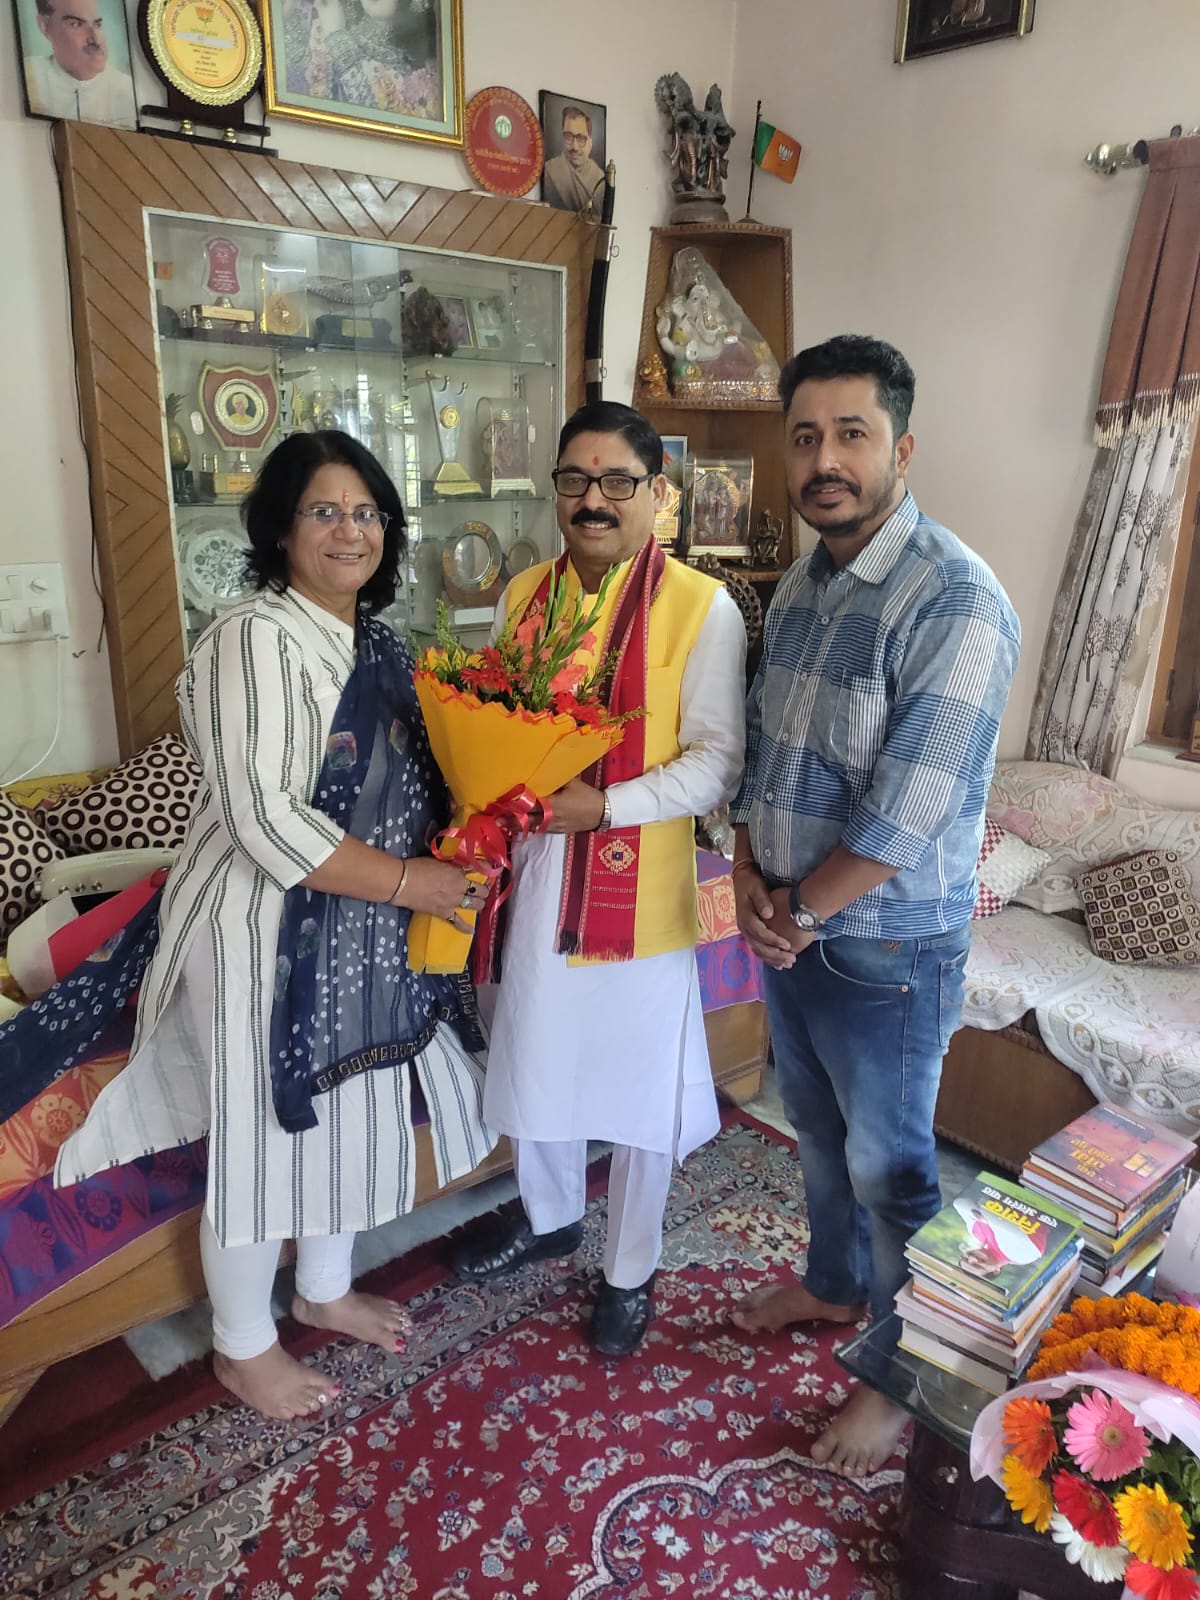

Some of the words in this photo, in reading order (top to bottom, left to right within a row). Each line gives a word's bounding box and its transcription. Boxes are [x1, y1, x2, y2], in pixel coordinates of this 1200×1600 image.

[981, 1186, 1002, 1200] पाठ
[1001, 1196, 1038, 1216] अंतरंग
[981, 1200, 1040, 1235] निशंक
[1037, 1213, 1058, 1228] एक
